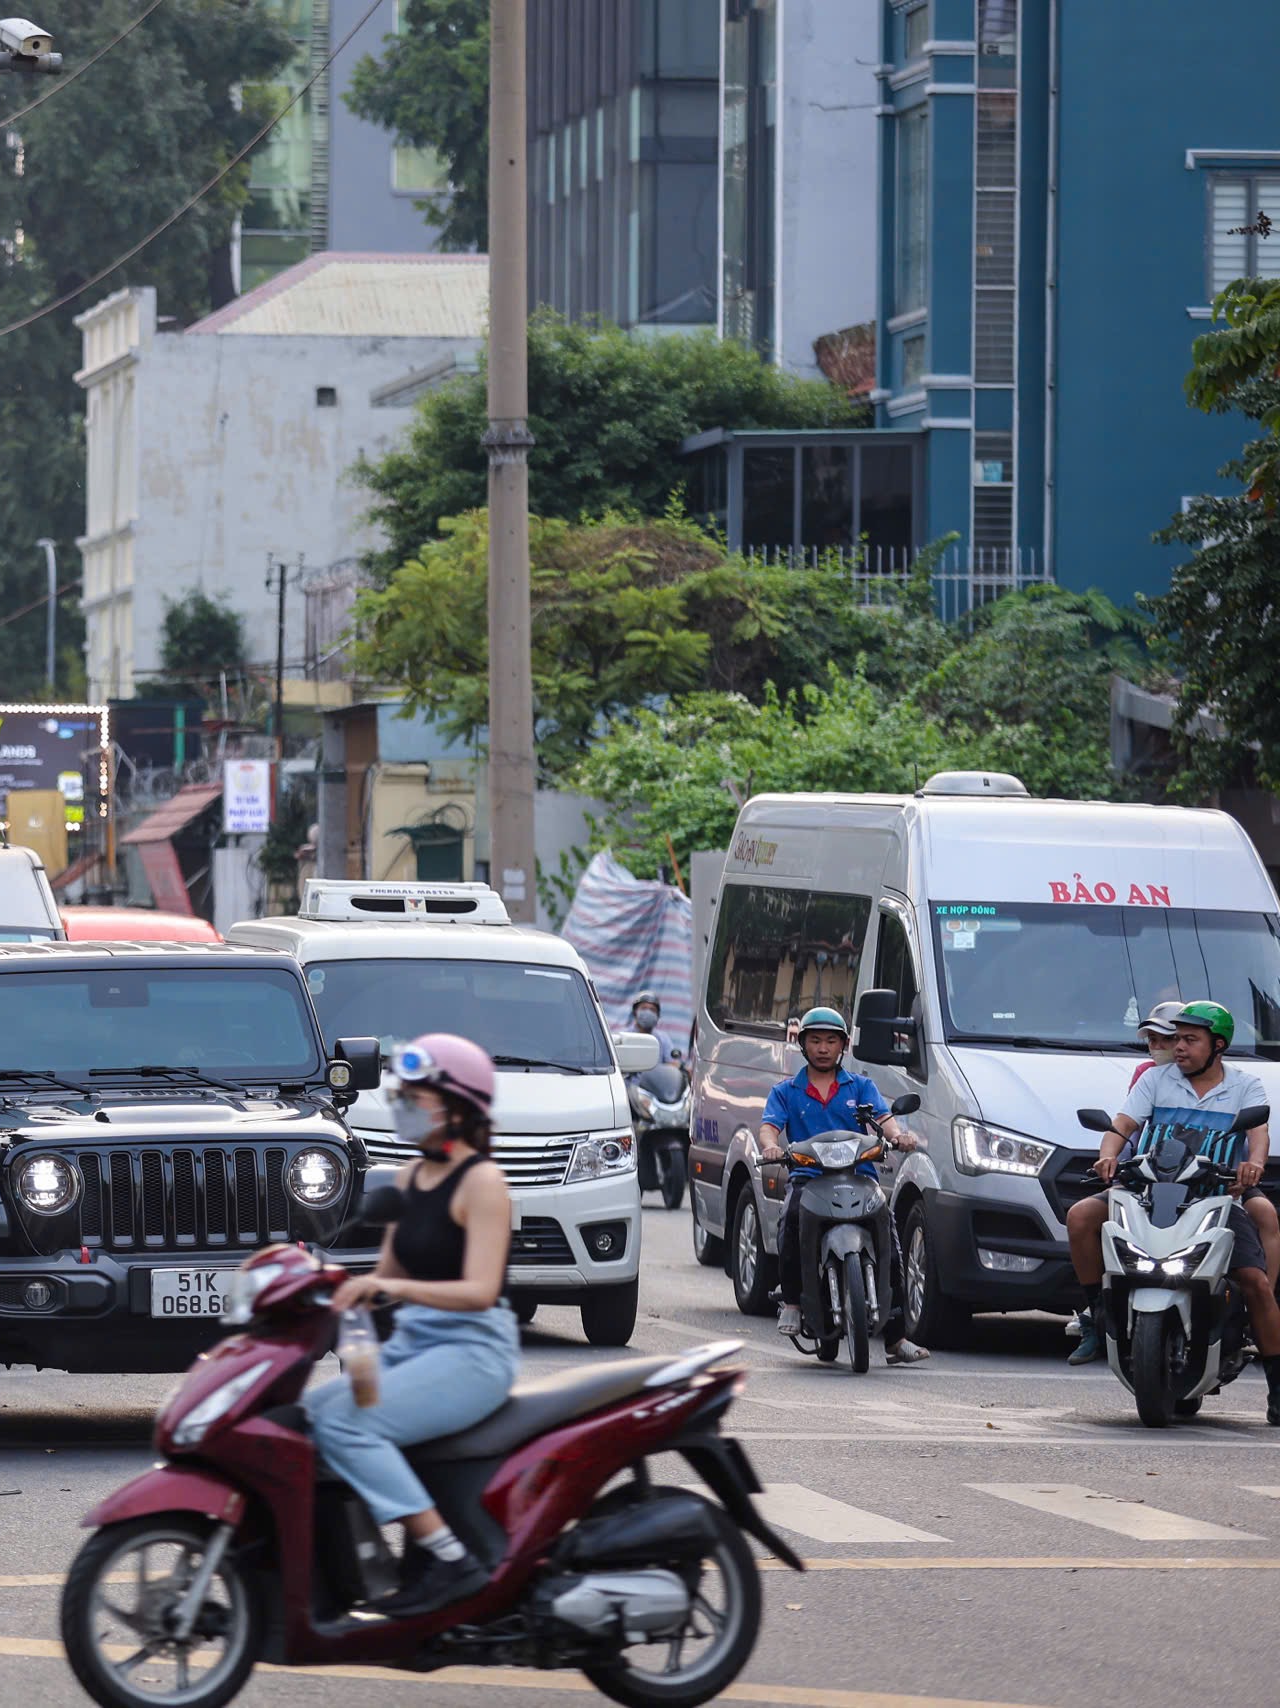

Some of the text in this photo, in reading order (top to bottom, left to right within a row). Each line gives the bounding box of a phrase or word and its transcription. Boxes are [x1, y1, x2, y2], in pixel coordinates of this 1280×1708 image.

[1048, 872, 1171, 907] BẢO AN
[936, 906, 948, 915] XE
[949, 905, 969, 916] HỢP
[178, 1272, 217, 1292] 51K
